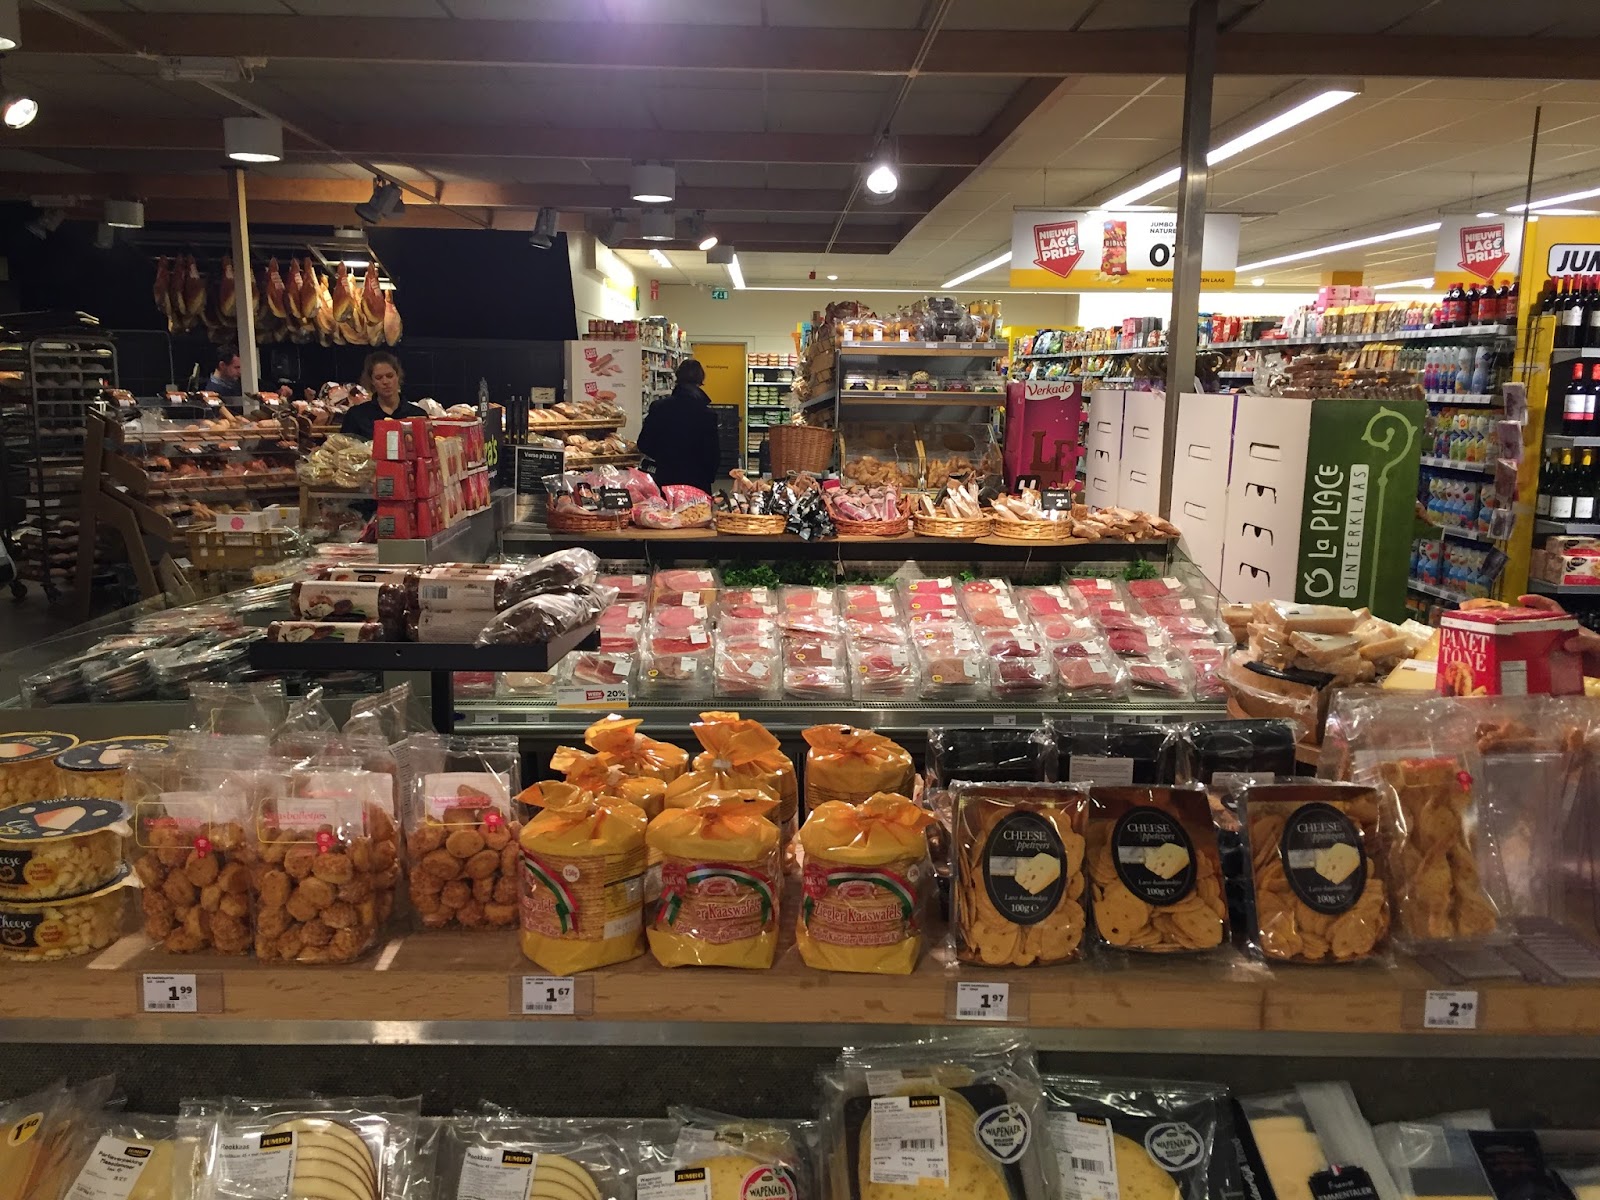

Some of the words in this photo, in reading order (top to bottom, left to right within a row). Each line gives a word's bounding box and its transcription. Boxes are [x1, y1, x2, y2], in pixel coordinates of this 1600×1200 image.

[1039, 227, 1075, 240] NIEUWE
[1465, 230, 1502, 243] NIEUWE
[1042, 246, 1078, 262] PRIJS
[1466, 249, 1503, 264] PRIJS
[1027, 383, 1071, 396] Verkade
[1309, 464, 1345, 531] PLACE
[1342, 471, 1367, 591] SINTERKLAAS
[1308, 538, 1338, 559] La
[1127, 823, 1170, 833] CHEESE
[1297, 822, 1341, 833] CHEESE
[1003, 830, 1047, 841] CHEESE
[1146, 887, 1166, 896] 100g
[1317, 895, 1336, 904] 100g
[708, 898, 761, 919] Kaaswafels
[814, 900, 846, 922] Ziegler
[847, 903, 902, 922] Kaaswafels
[1011, 904, 1030, 913] 100g
[985, 1125, 1022, 1137] WAPENAER
[262, 1136, 291, 1146] JUMBO
[1155, 1139, 1192, 1149] WAPENAER
[677, 1172, 704, 1181] JUMBO
[750, 1185, 786, 1197] WAPENAER
